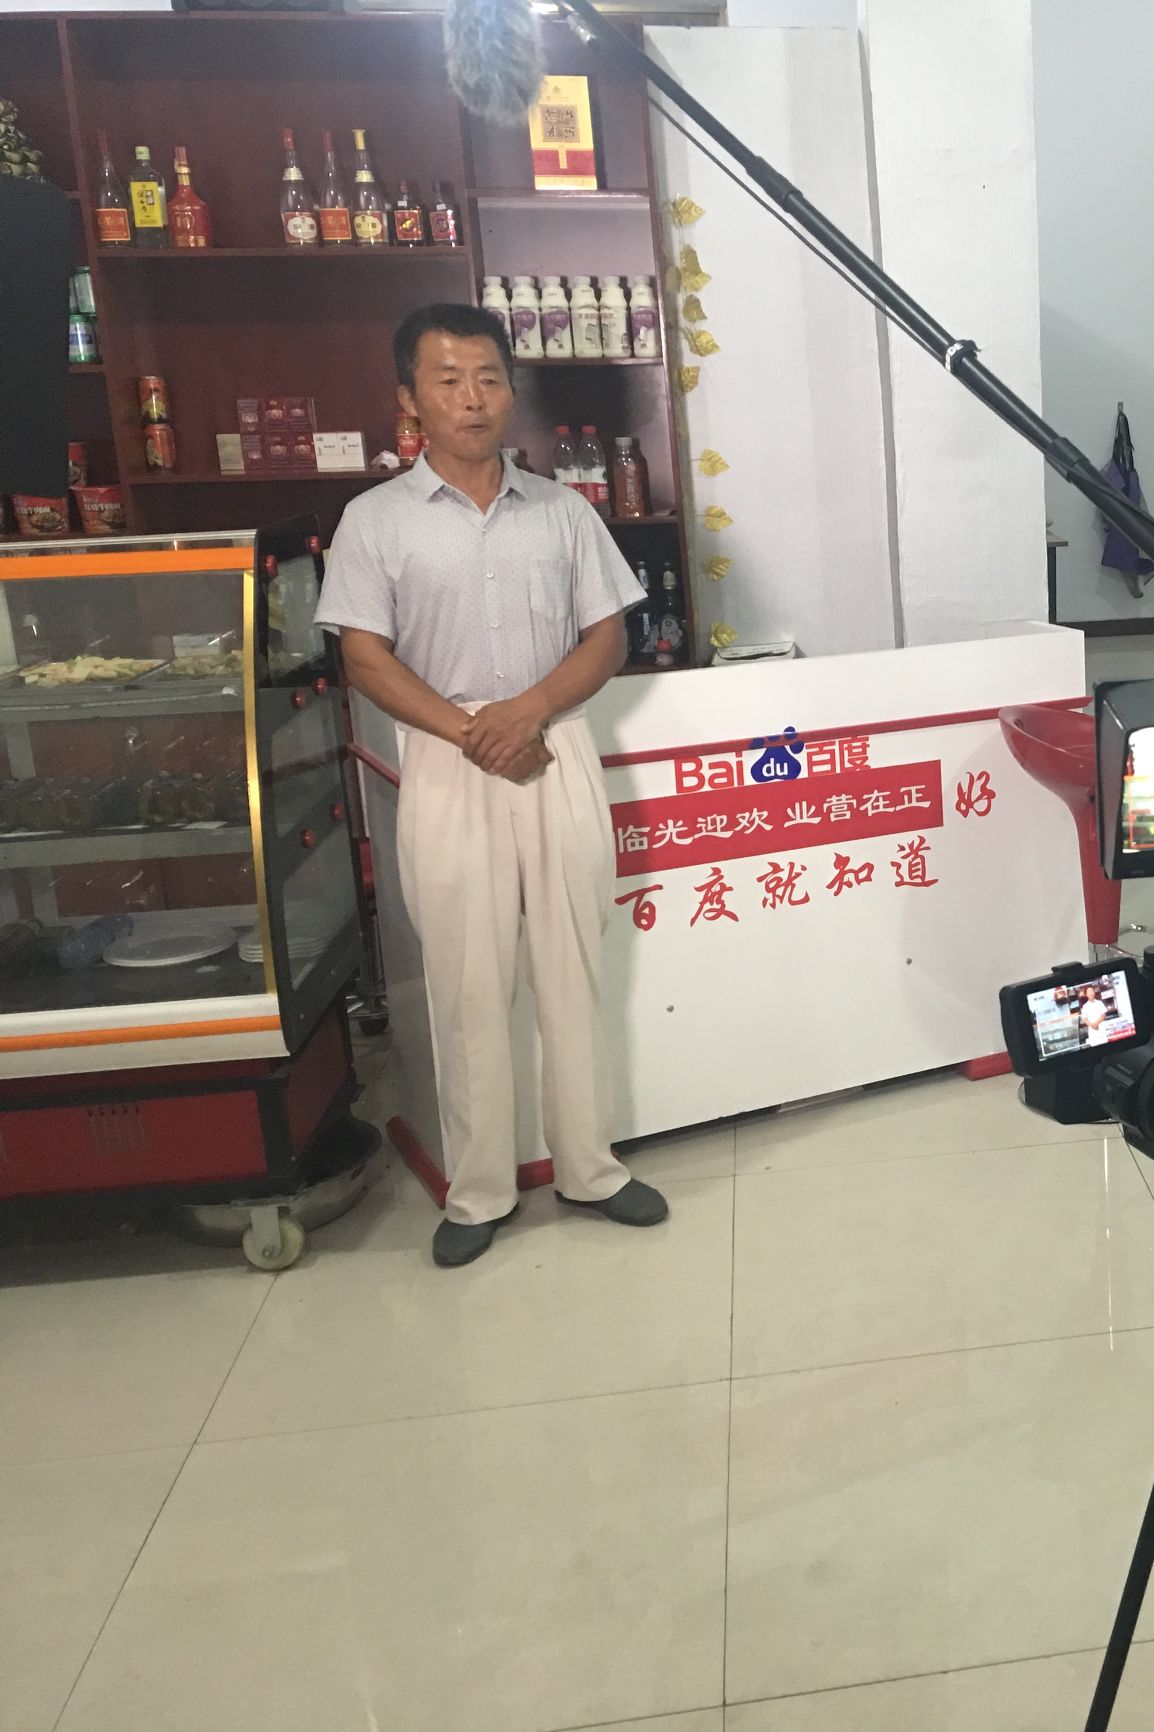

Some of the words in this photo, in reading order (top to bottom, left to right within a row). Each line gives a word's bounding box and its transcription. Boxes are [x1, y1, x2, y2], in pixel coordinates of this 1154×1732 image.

[674, 751, 744, 794] Bai
[762, 757, 788, 777] du
[805, 736, 872, 777] 百度
[955, 770, 997, 818] 好
[618, 807, 774, 854] 临光迎欢
[783, 783, 932, 828] 业营在正
[614, 835, 939, 932] 百度就知道
